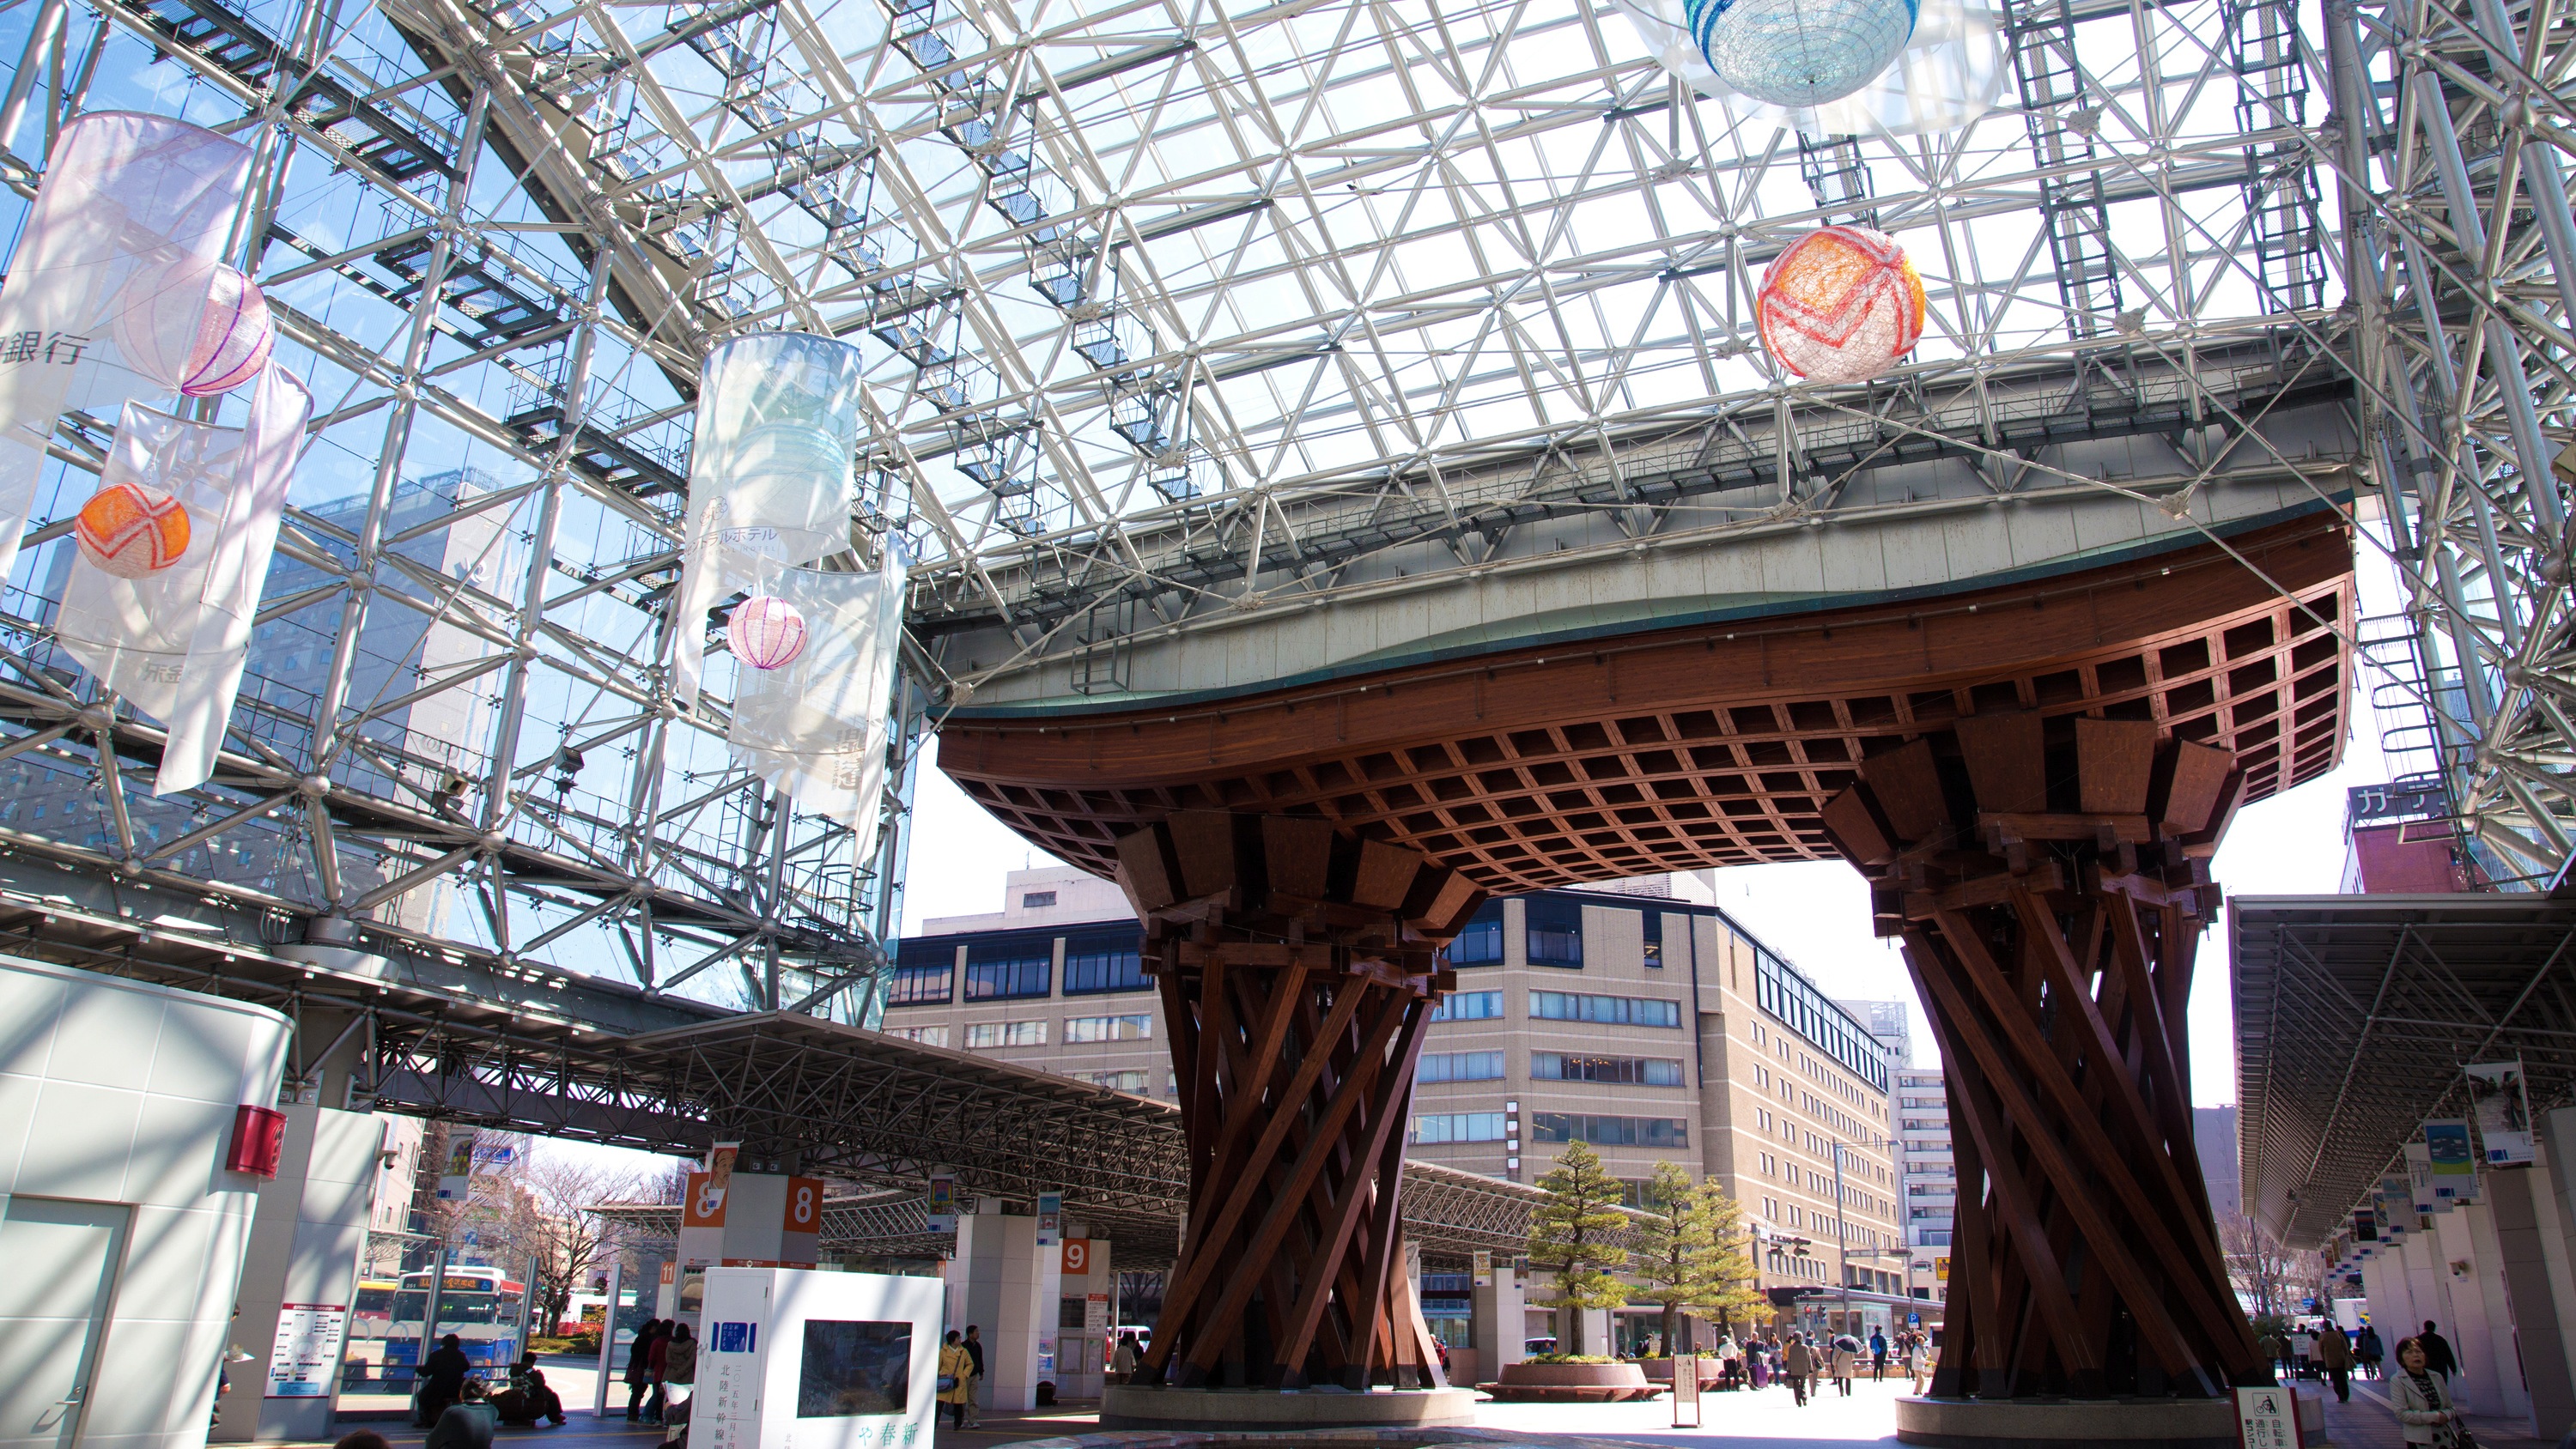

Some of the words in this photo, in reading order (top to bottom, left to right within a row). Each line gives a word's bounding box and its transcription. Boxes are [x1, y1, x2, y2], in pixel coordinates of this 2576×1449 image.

[0, 331, 90, 365] 銀行
[696, 1181, 715, 1218] 8
[794, 1186, 813, 1223] 8
[1066, 1244, 1084, 1269] 9
[663, 1264, 674, 1281] 11
[1910, 1313, 1917, 1322] P
